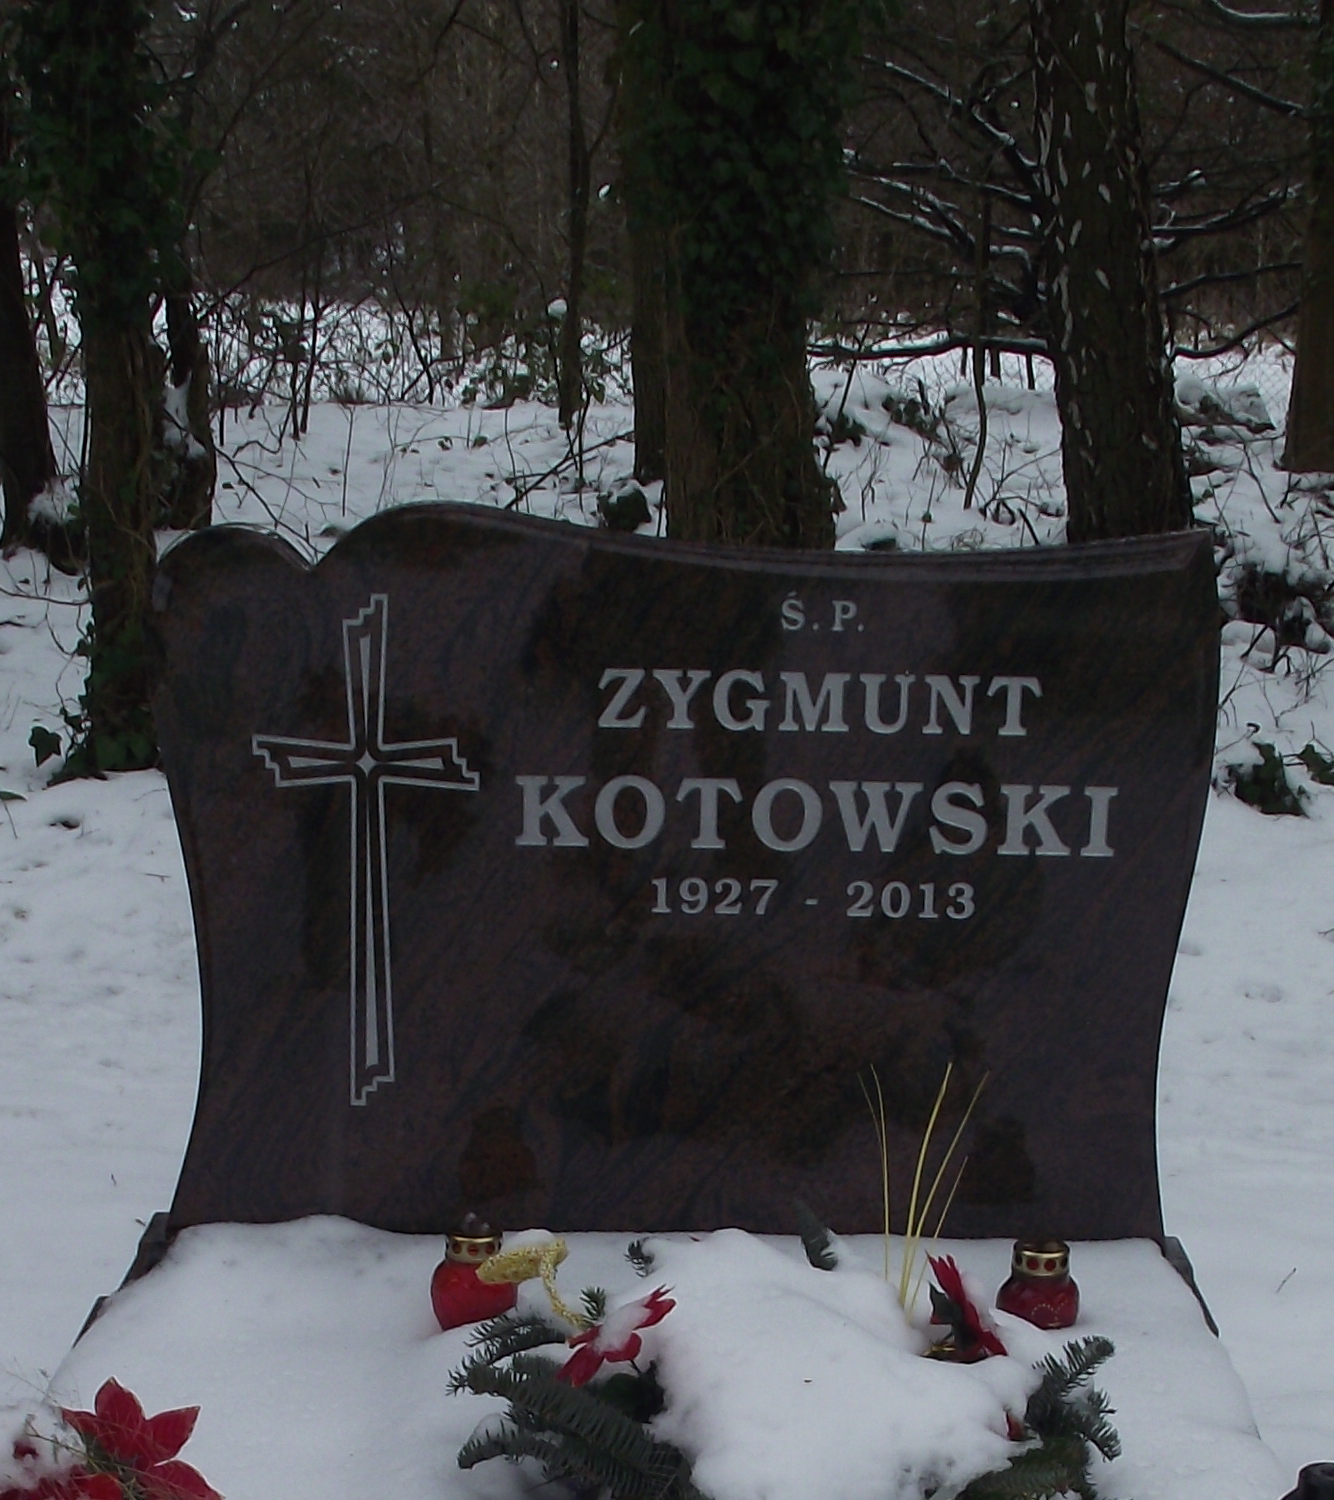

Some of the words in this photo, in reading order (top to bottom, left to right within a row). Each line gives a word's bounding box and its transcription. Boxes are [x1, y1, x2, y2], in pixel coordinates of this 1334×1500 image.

[597, 667, 1043, 737] ZYGMUNT
[514, 773, 1119, 858] KOTOWSKI
[650, 876, 779, 916] 1927
[846, 879, 976, 921] 2013
